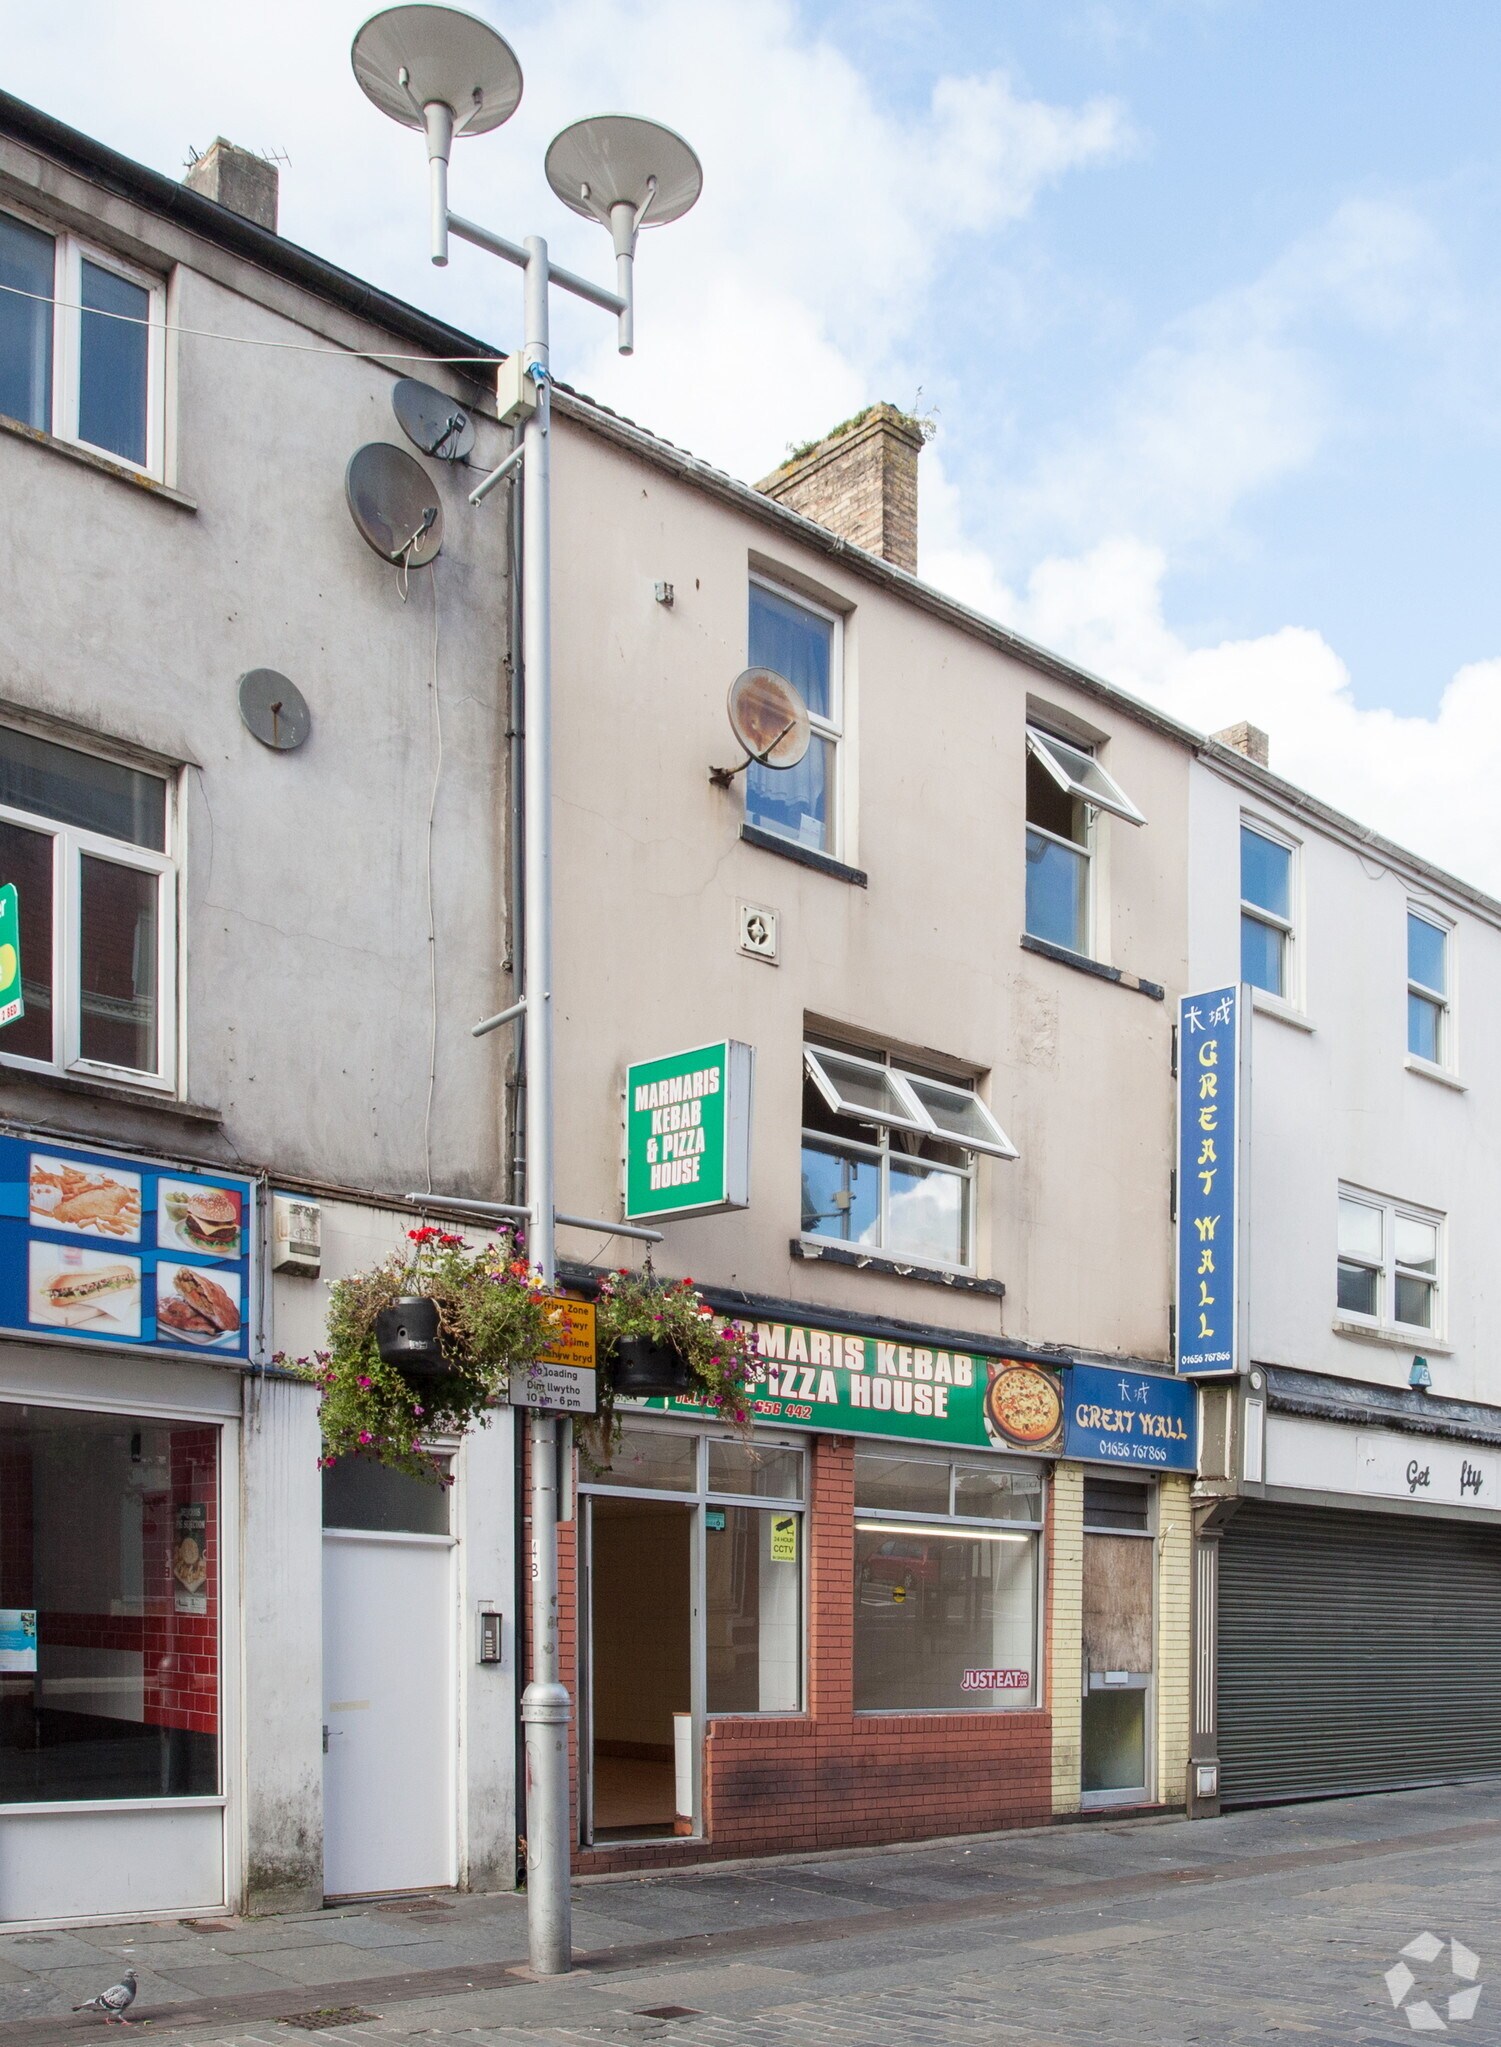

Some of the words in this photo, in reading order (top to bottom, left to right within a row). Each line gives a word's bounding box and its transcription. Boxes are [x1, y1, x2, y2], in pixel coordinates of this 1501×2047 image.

[635, 1066, 720, 1112] MARMARIS
[652, 1100, 702, 1135] KEBAB
[1197, 1039, 1218, 1195] GREAT
[646, 1137, 659, 1163] &
[662, 1127, 706, 1160] PIZZA
[650, 1156, 700, 1190] HOUSE
[1193, 1215, 1220, 1339] WALL
[543, 1301, 564, 1312] trian
[567, 1304, 589, 1315] Zone
[572, 1352, 593, 1363] bryd
[876, 1341, 973, 1387] KEBAB
[1181, 1354, 1203, 1365] 01656
[1204, 1351, 1231, 1362] 767866
[526, 1380, 545, 1390] Dim
[547, 1383, 581, 1395] llwytho
[544, 1367, 578, 1381] loading
[526, 1393, 537, 1402] 10
[559, 1397, 566, 1405] 6
[567, 1399, 581, 1407] pm
[744, 1360, 839, 1404] PIZZA
[850, 1374, 949, 1418] HOUSE
[785, 1404, 812, 1420] 442
[1075, 1403, 1135, 1433] GREAT
[1138, 1412, 1188, 1440] WALL
[1099, 1440, 1130, 1457] 01656
[1132, 1444, 1167, 1461] 767866
[1406, 1460, 1430, 1493] Get
[773, 1544, 794, 1553] CCTV
[963, 1671, 995, 1688] JUST
[996, 1671, 1020, 1687] EAT
